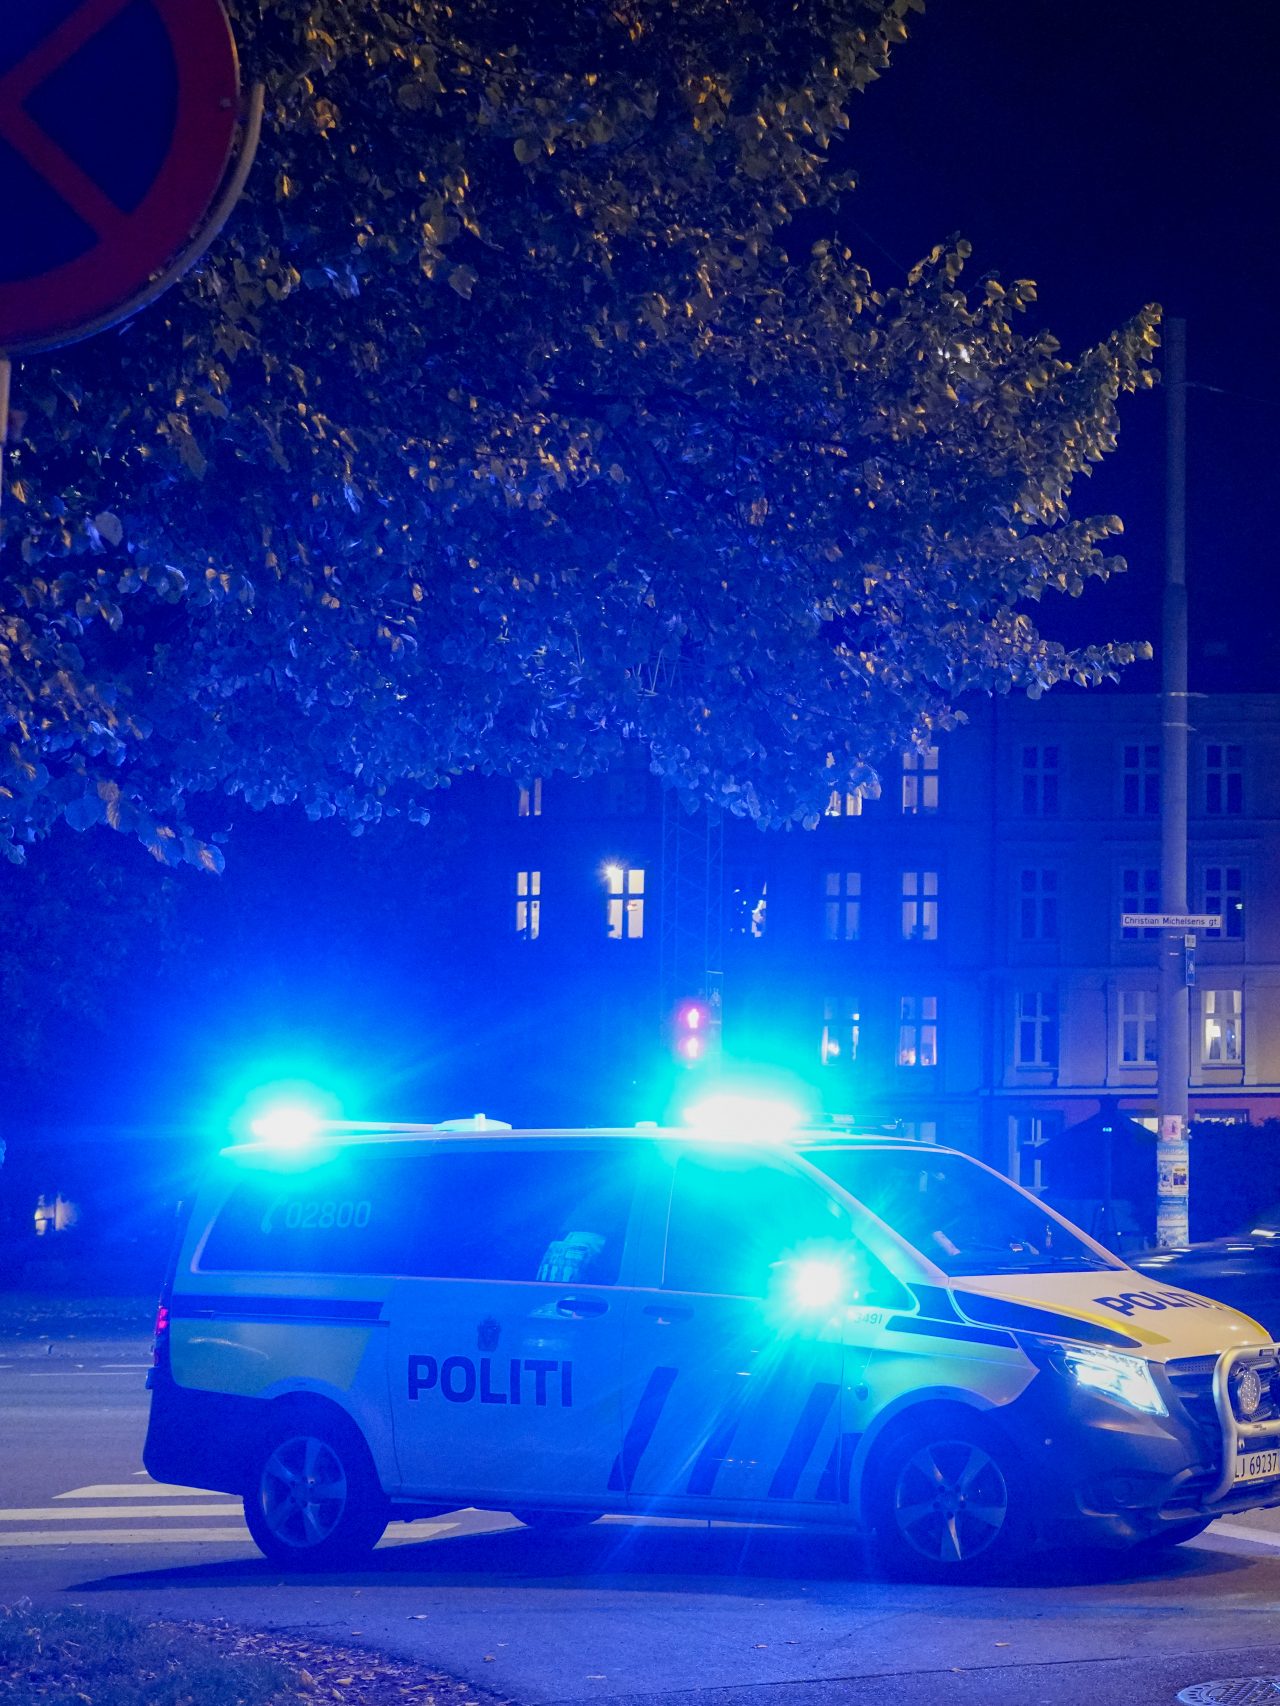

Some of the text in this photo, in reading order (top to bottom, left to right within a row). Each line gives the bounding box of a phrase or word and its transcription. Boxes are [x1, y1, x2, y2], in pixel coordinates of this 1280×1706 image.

[1124, 916, 1160, 925] Christian
[1162, 917, 1206, 926] Michelsens
[284, 1200, 372, 1229] 02800
[407, 1353, 573, 1408] POLITI
[1249, 1452, 1278, 1476] 69237
